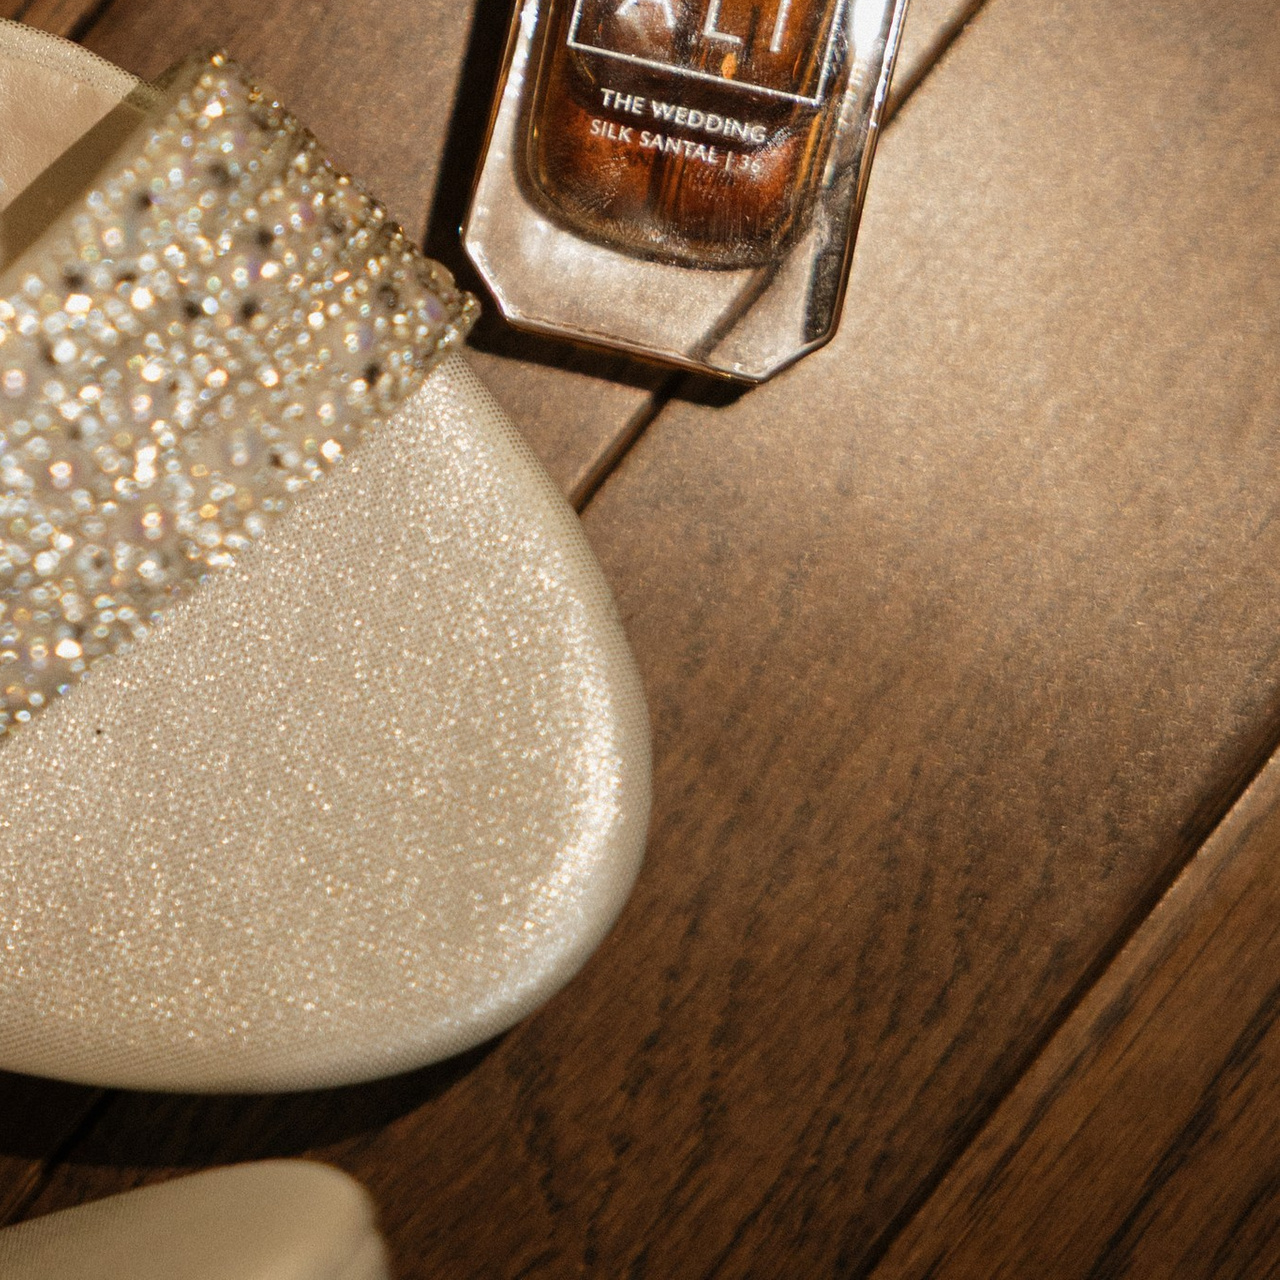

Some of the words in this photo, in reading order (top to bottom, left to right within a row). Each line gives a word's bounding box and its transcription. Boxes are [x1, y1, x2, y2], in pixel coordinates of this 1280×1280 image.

[600, 87, 646, 115] THE
[651, 99, 767, 143] WEDDING
[589, 118, 634, 144] SILK
[639, 130, 719, 165] SANTAL
[737, 154, 763, 174] 36
